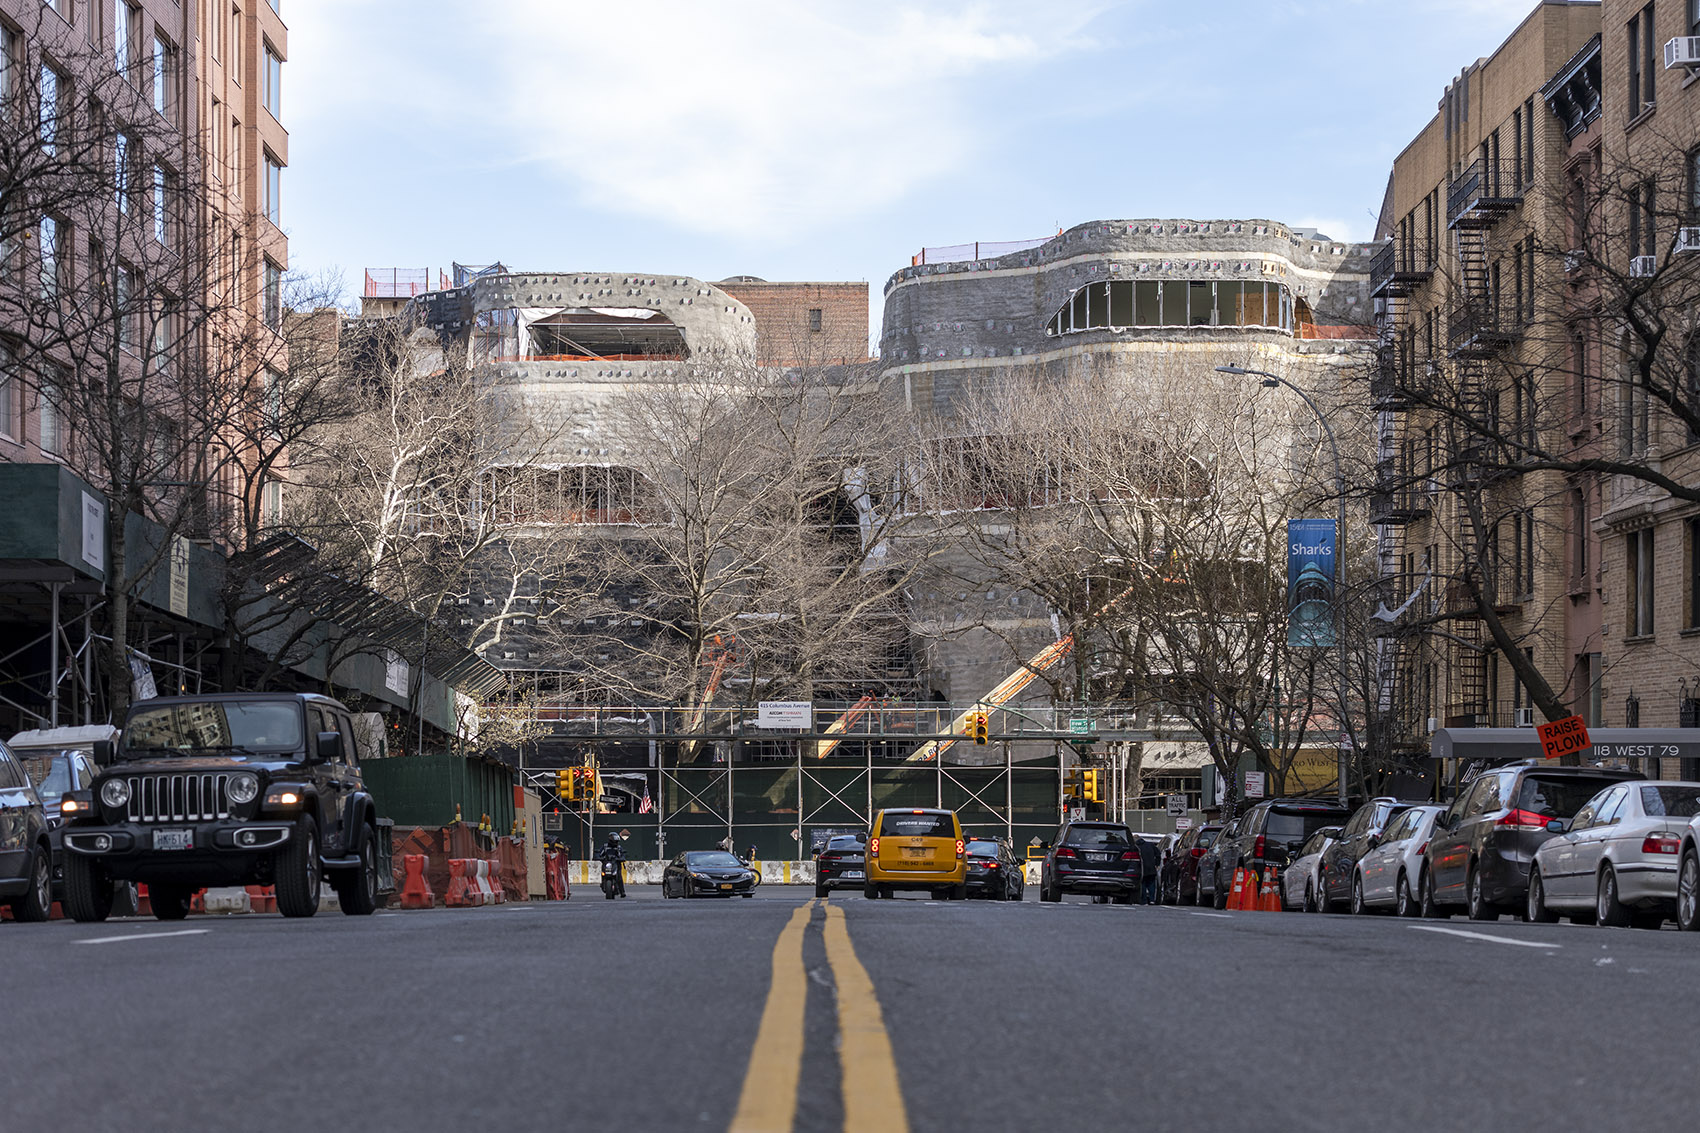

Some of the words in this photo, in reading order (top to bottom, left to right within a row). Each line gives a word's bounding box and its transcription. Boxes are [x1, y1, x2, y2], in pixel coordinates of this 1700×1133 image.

[1292, 542, 1332, 556] Sharks
[1544, 719, 1580, 739] RAISE
[1546, 732, 1586, 756] PLOW
[1594, 746, 1610, 756] 118
[1615, 746, 1654, 756] WEST
[1660, 746, 1679, 756] 79
